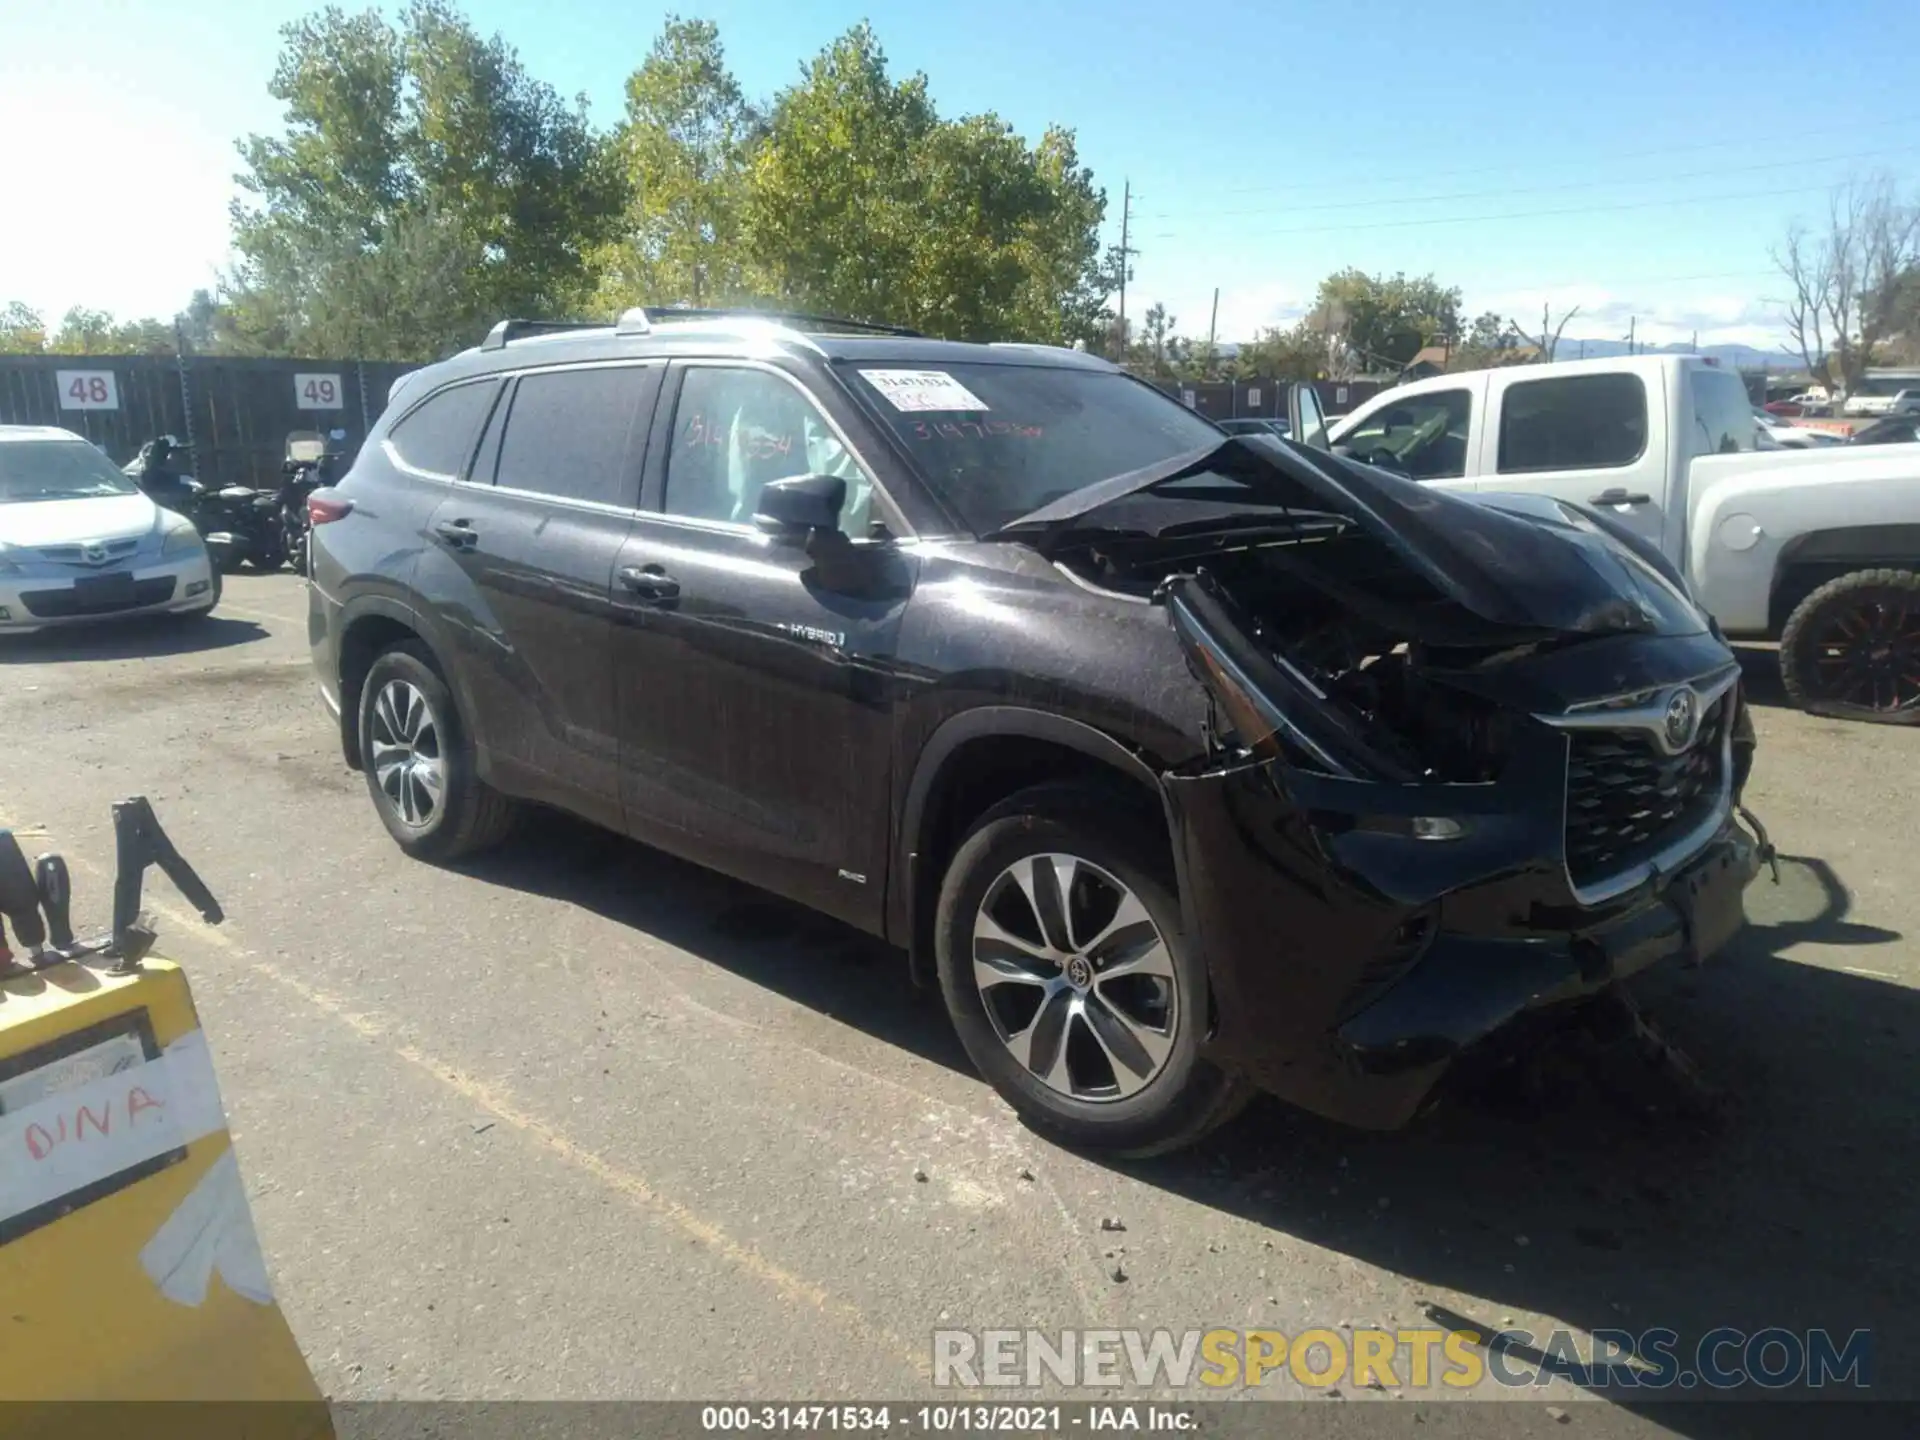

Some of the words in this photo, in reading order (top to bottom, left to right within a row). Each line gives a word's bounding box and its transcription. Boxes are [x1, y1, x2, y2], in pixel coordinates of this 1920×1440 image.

[68, 377, 108, 403] 48
[304, 380, 334, 403] 49
[790, 623, 836, 645] HYBRID
[25, 1086, 165, 1161] DINA
